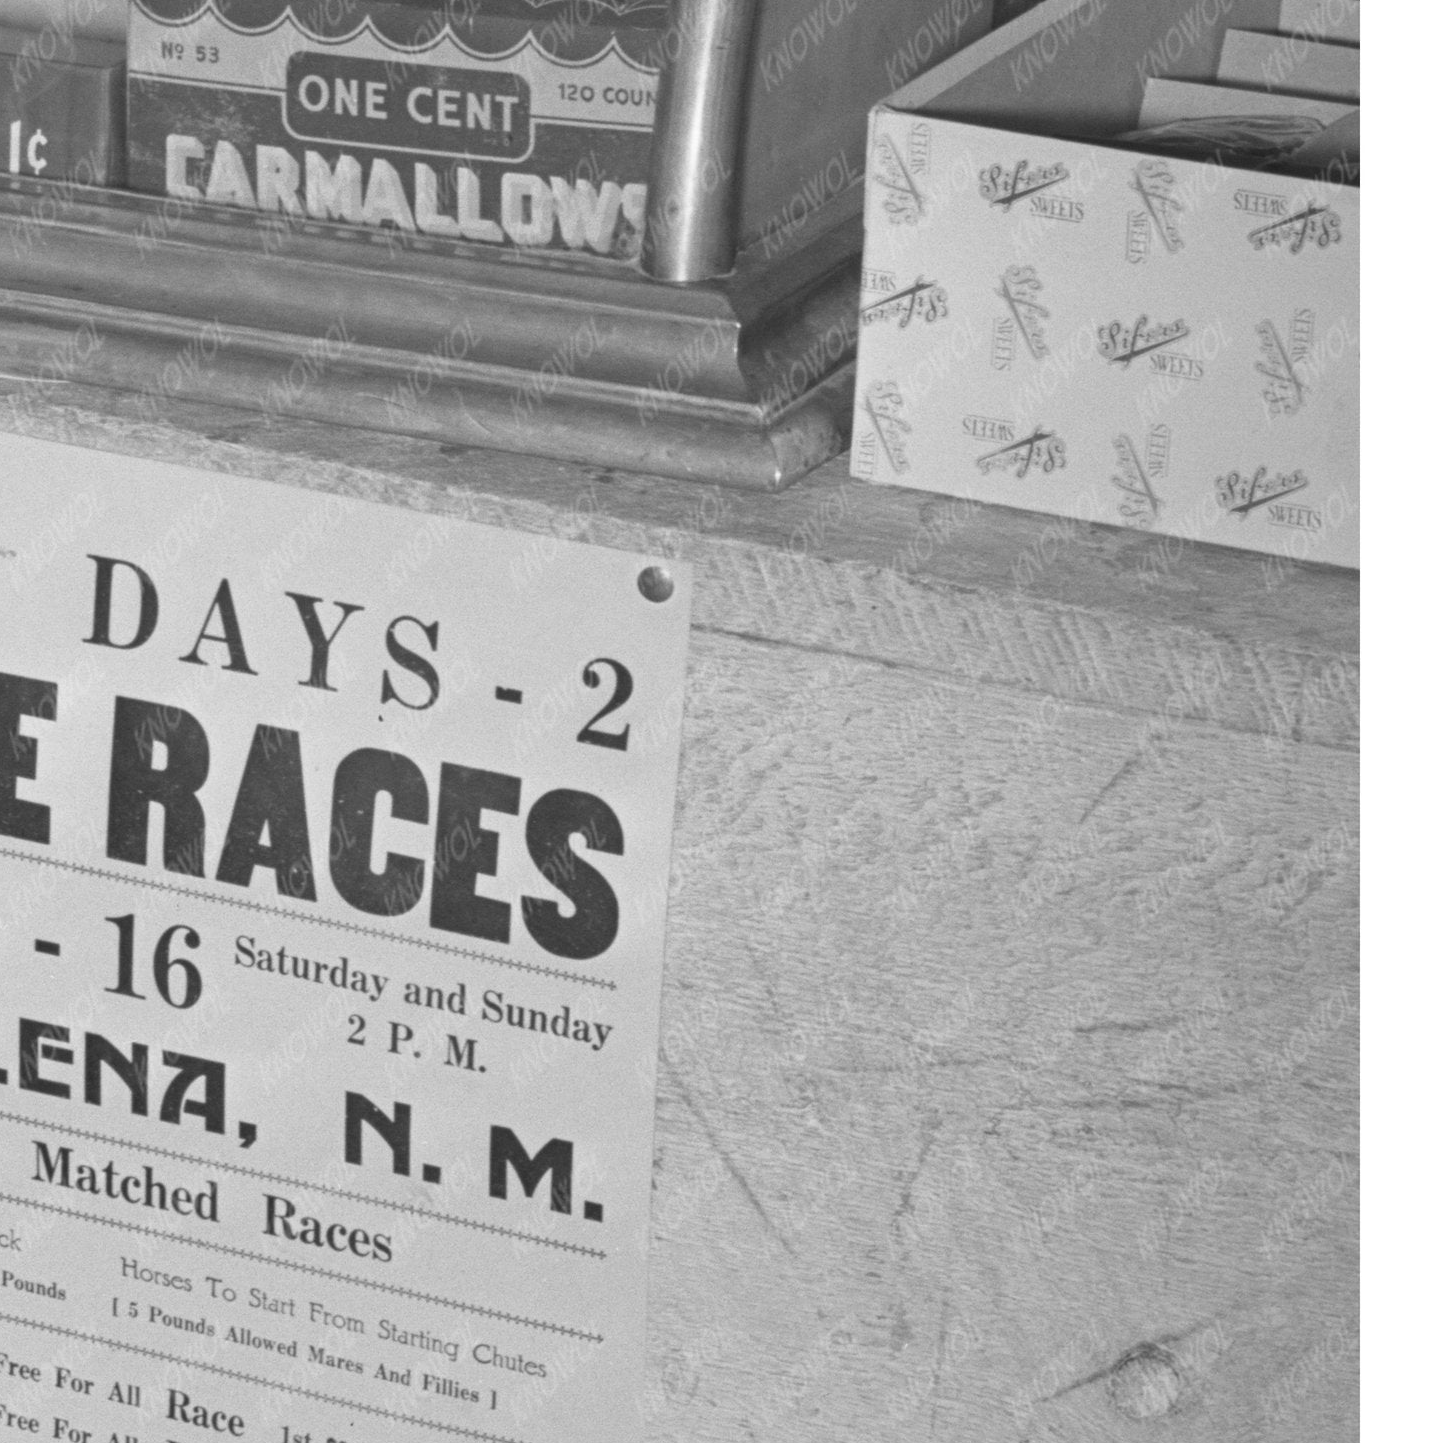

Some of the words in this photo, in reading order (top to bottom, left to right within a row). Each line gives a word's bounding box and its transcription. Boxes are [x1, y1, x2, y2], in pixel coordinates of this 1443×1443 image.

[195, 44, 221, 65] 53
[297, 75, 389, 120] ONE
[406, 86, 520, 134] CENT
[557, 82, 596, 103] 120
[602, 84, 658, 107] COUN
[1029, 197, 1085, 221] SWEETS
[1148, 353, 1204, 378] SWEETS
[81, 552, 444, 714] DAYS
[573, 655, 634, 752] 2
[105, 693, 625, 962] RACES
[102, 910, 203, 1011] 16
[231, 934, 390, 1001] Saturday
[403, 973, 469, 1016] and
[480, 987, 615, 1054] Sunday
[30, 1139, 221, 1224] Matched
[261, 1193, 394, 1264] Races
[344, 1089, 444, 1185] N.
[487, 1124, 605, 1223] M.
